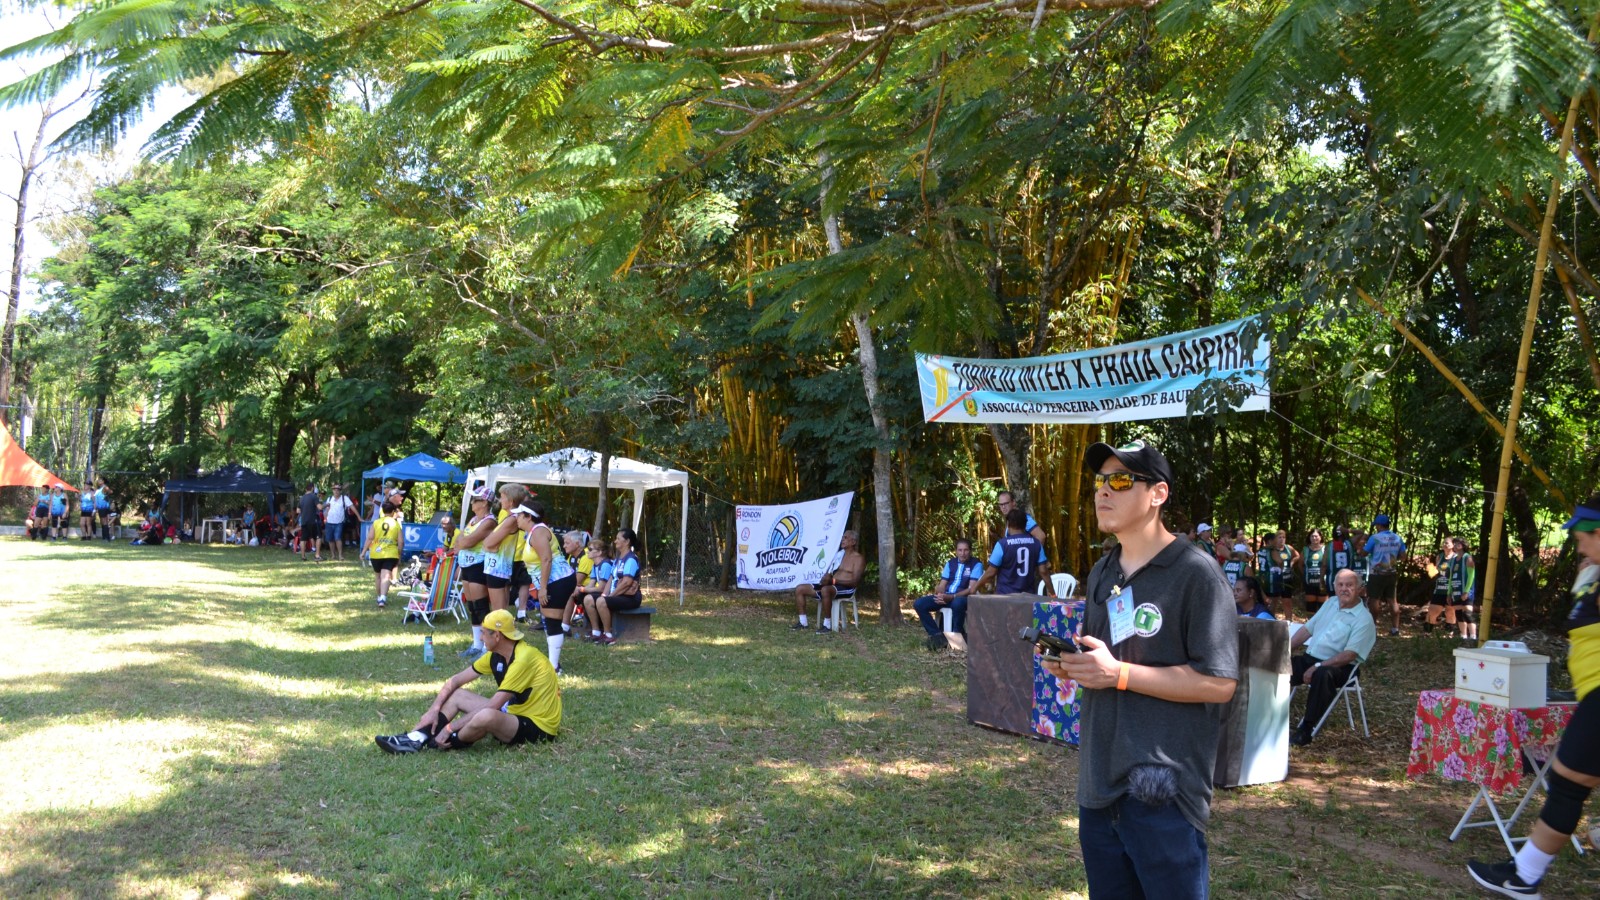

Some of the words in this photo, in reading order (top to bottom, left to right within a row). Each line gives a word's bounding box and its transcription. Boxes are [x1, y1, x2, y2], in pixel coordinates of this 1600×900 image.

[952, 362, 1016, 393] TORNEIO
[1018, 361, 1072, 393] INTER
[1073, 358, 1090, 389] X
[1090, 348, 1162, 388] PRAIA
[1161, 331, 1255, 379] CAIPIRA
[981, 401, 1043, 416] ASSOCIAÇÃO
[1045, 400, 1100, 414] TERCEIRA
[1100, 395, 1140, 411] IDADE
[1141, 392, 1158, 407] DE
[381, 522, 390, 537] 9
[762, 549, 800, 566] VOLEIBOL
[1016, 546, 1030, 577] 9
